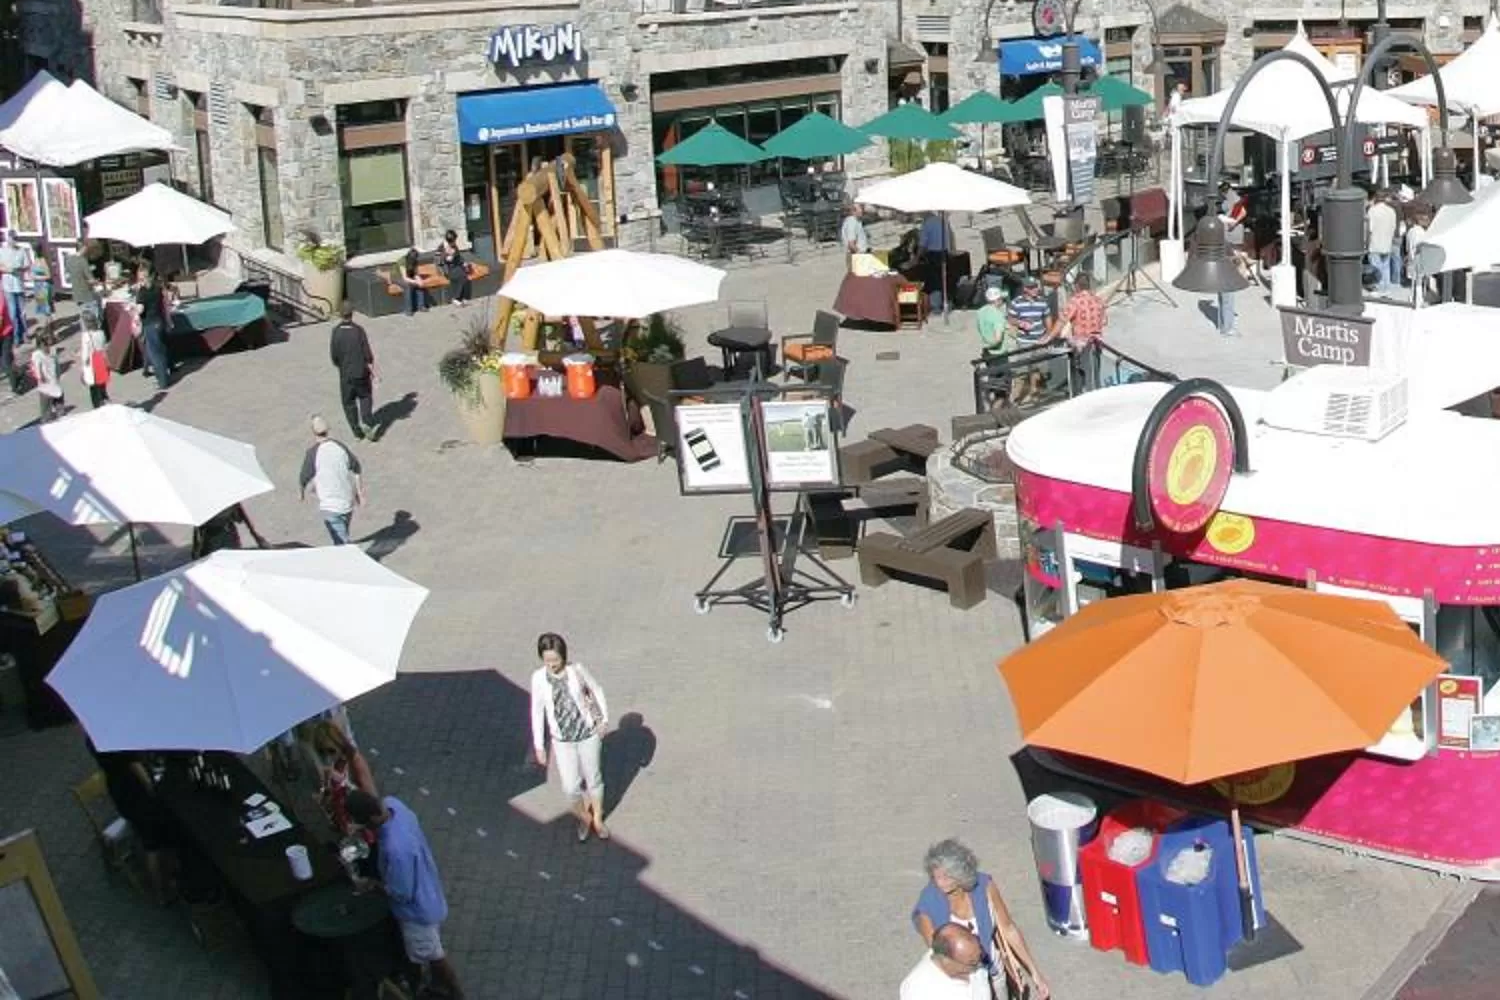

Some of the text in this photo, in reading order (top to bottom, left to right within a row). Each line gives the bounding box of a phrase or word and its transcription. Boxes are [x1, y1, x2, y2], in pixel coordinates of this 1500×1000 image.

[493, 23, 581, 67] MIKUNI
[1070, 99, 1097, 109] Martis
[1071, 109, 1095, 121] Camp
[1295, 316, 1360, 343] Martis
[1297, 337, 1355, 366] Camp
